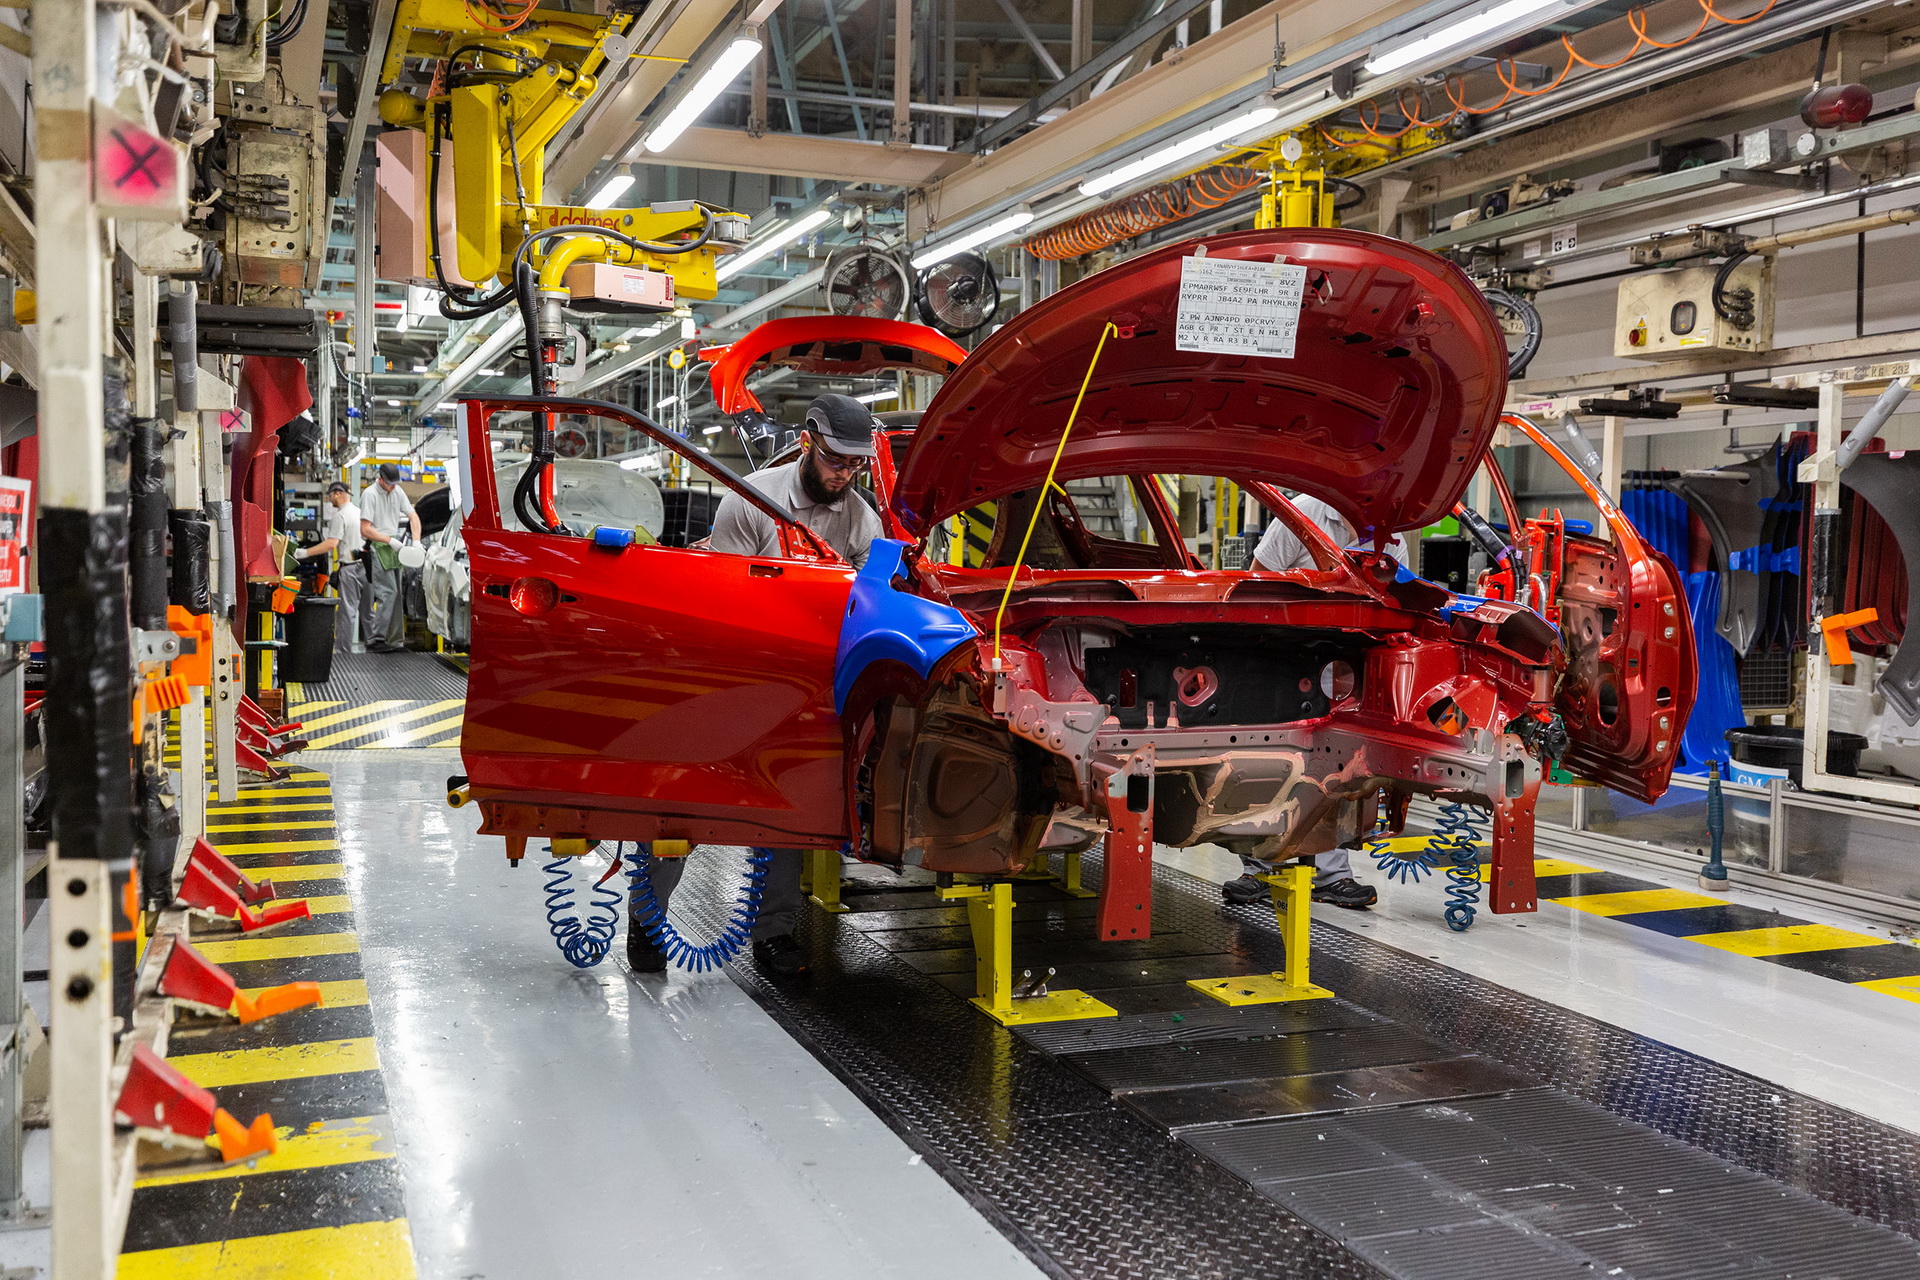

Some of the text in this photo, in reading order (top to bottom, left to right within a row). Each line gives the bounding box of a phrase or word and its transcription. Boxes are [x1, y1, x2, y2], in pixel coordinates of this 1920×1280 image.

[560, 208, 620, 232] dalmec
[1181, 293, 1208, 301] RYPRR
[1247, 297, 1258, 305] PA
[1190, 313, 1200, 321] PW
